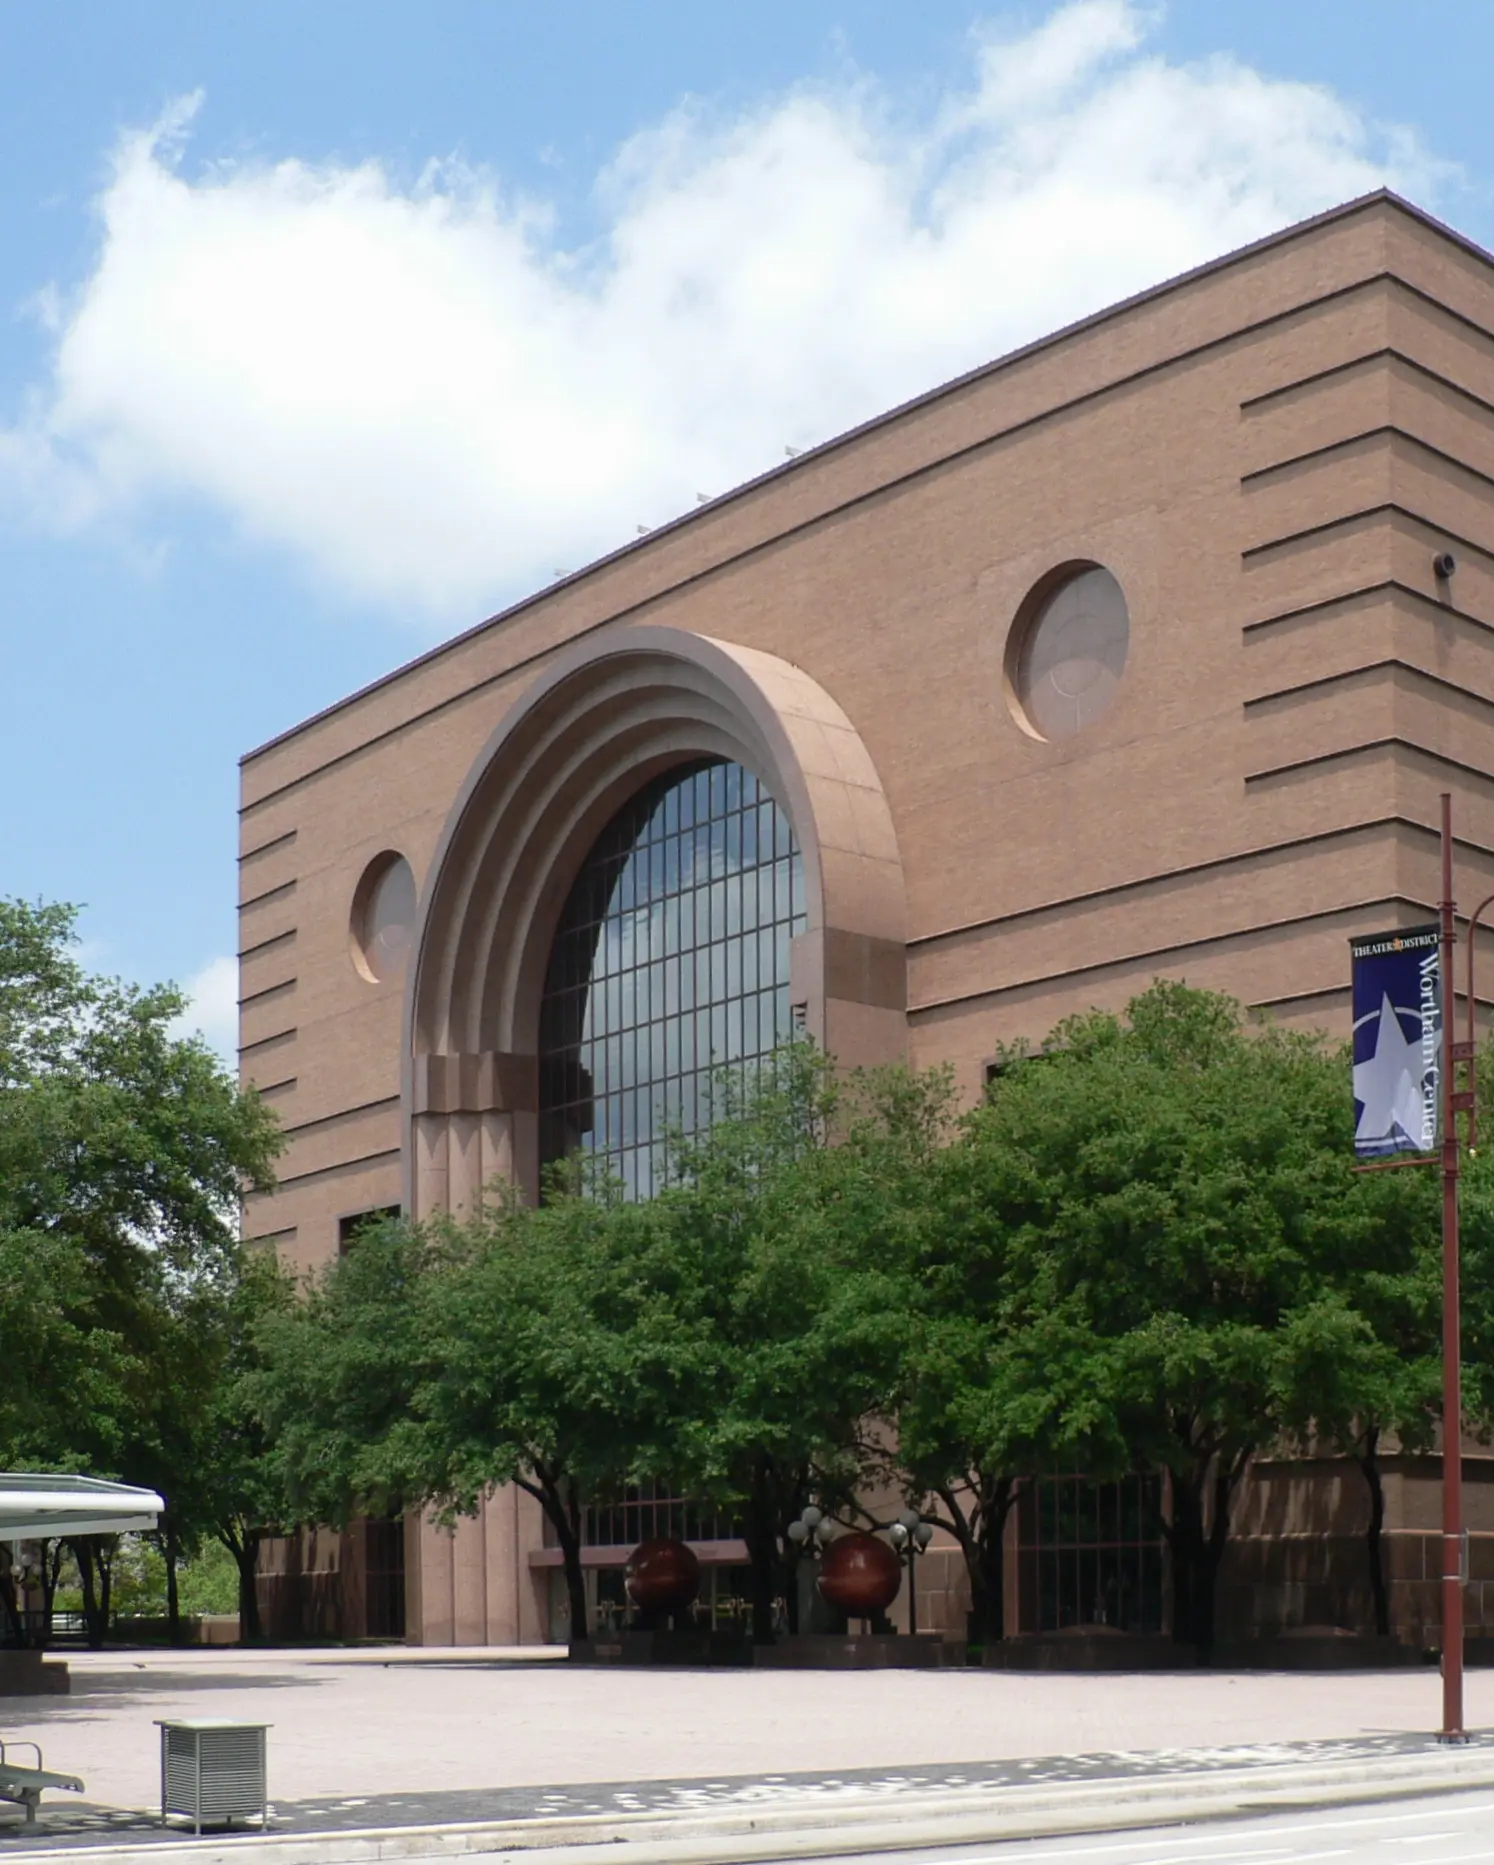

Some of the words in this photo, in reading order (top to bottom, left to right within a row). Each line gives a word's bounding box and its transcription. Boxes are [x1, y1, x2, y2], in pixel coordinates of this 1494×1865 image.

[1353, 942, 1394, 958] THEATER
[1400, 933, 1438, 948] DISTRICT
[1418, 952, 1440, 1064] Wortham
